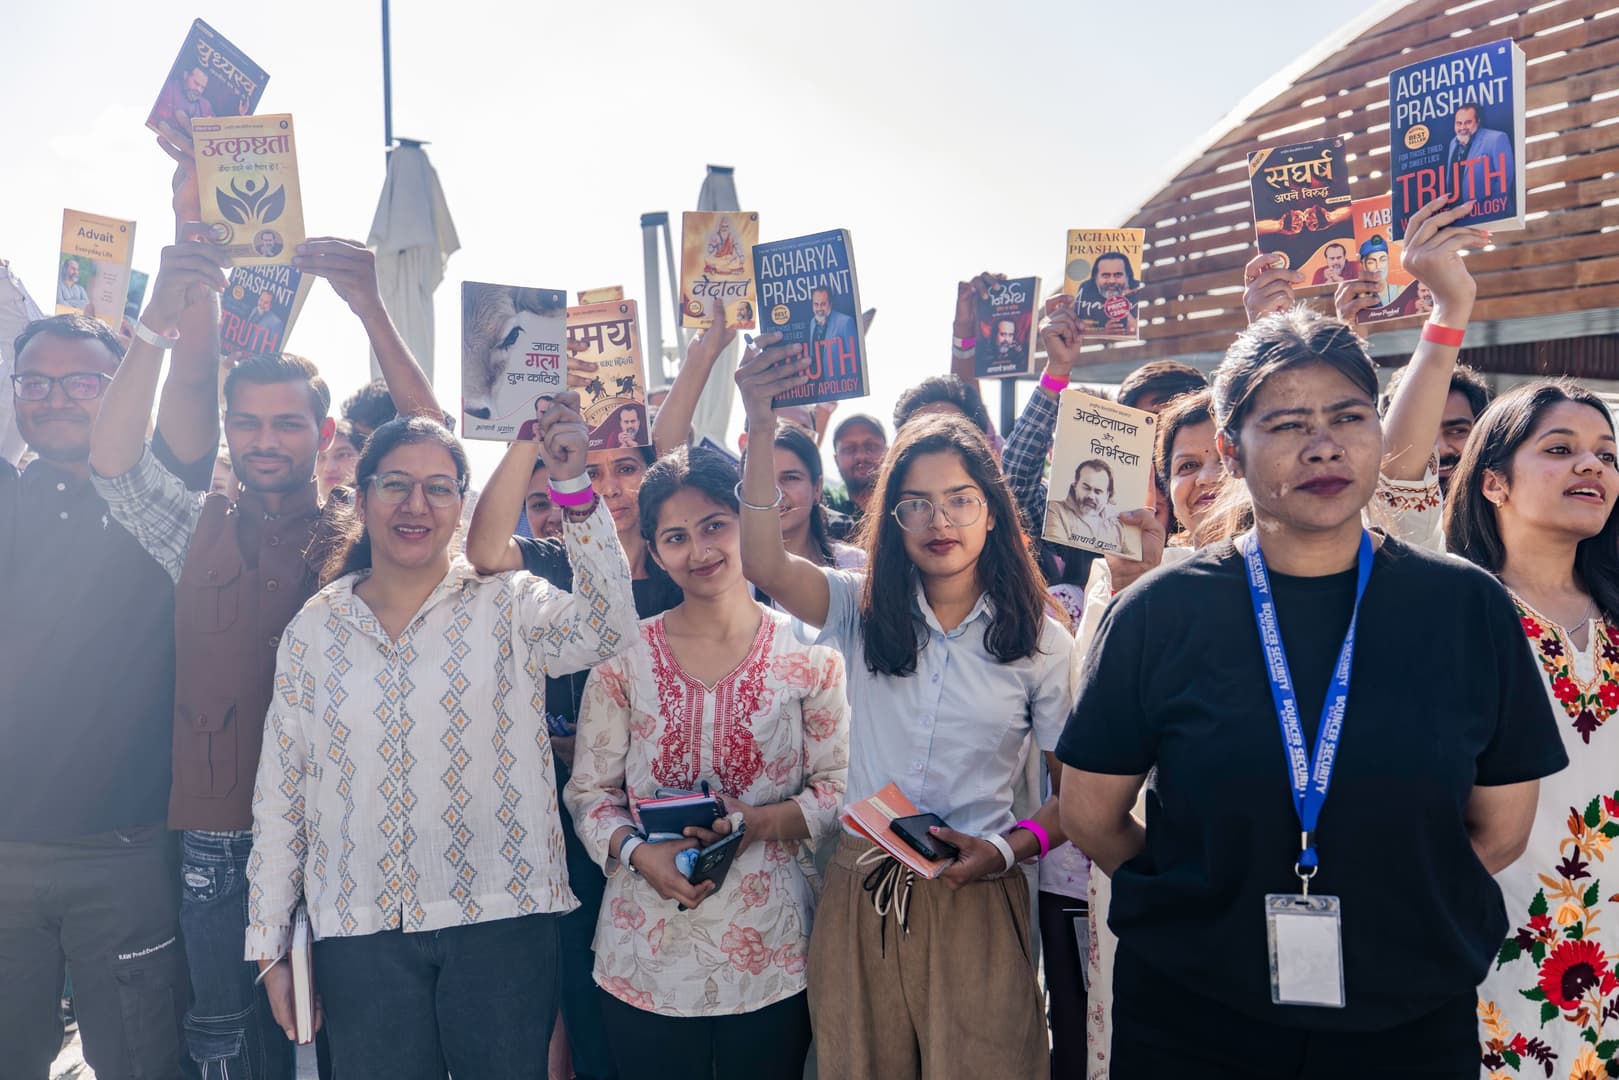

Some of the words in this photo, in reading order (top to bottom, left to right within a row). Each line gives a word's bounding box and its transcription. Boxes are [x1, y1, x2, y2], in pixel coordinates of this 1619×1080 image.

[1396, 52, 1494, 101] ACHARYA
[1397, 76, 1508, 129] PRASHANT
[200, 134, 290, 163] उत्कृष्टता
[1408, 131, 1425, 141] BEST
[1263, 149, 1333, 189] संघर्ष
[1396, 152, 1507, 214] TRUTH
[1274, 189, 1299, 203] अपने
[1470, 197, 1508, 218] OLOGY
[1363, 207, 1392, 229] KAB
[77, 226, 114, 244] Advait
[1075, 232, 1137, 242] ACHARYA
[760, 244, 838, 280] ACHARYA
[1069, 245, 1141, 255] PRASHANT
[231, 266, 295, 307] PRASHANT
[692, 274, 752, 299] वेदान्त
[762, 269, 849, 307] PRASHANT
[220, 309, 279, 354] TRUTH
[525, 353, 560, 371] गला
[532, 342, 559, 353] जाका
[507, 372, 525, 384] तुम
[818, 378, 859, 396] APOLOGY
[1073, 408, 1139, 437] अकेलापन
[1103, 432, 1115, 442] और
[1090, 438, 1140, 467] निर्भरता
[1252, 552, 1269, 594] SECURITY
[1261, 602, 1279, 646] BOUNCER
[1271, 645, 1291, 690] SECURITY
[1327, 695, 1347, 742] BOUNCER
[1282, 698, 1303, 746] BOUNCER
[1295, 747, 1309, 798] SECURI
[1314, 742, 1336, 794] SECURITY
